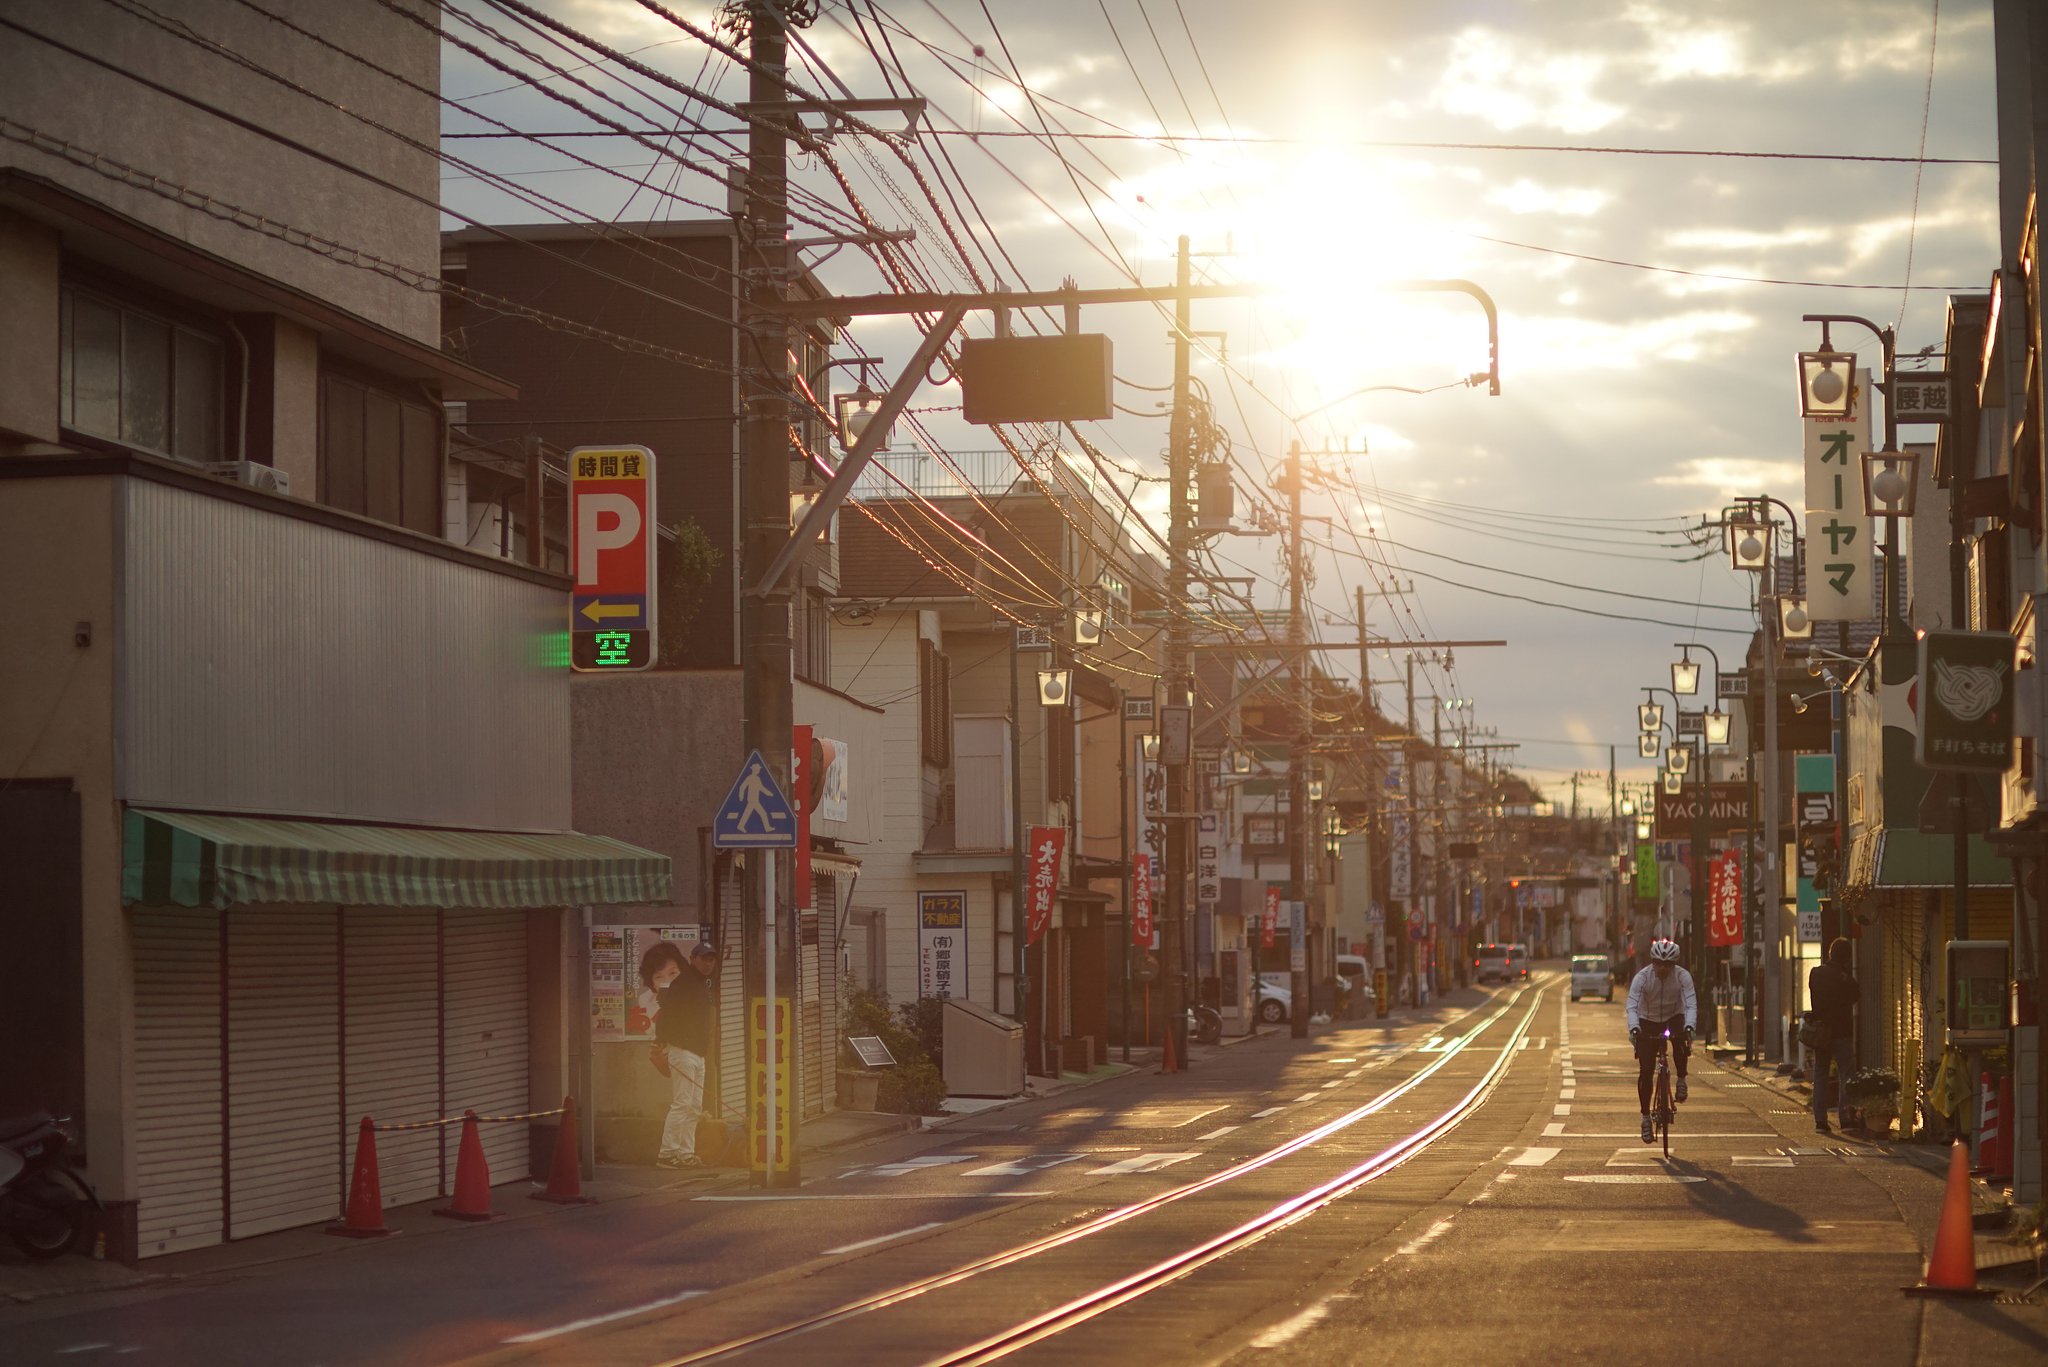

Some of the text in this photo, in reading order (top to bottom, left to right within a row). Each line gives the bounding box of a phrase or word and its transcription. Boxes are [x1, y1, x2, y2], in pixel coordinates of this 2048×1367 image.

[1896, 386, 1947, 411] 腰越
[578, 455, 640, 477] 時間貸
[1820, 430, 1857, 597] オーヤマ
[577, 493, 641, 586] P
[595, 631, 630, 665] 空
[1720, 679, 1747, 694] 腰越
[1030, 840, 1057, 932] 大売出し
[1136, 862, 1150, 937] 大売出し
[1721, 858, 1738, 936] 大売出し
[923, 898, 961, 910] ガラス
[923, 912, 961, 926] 不動産
